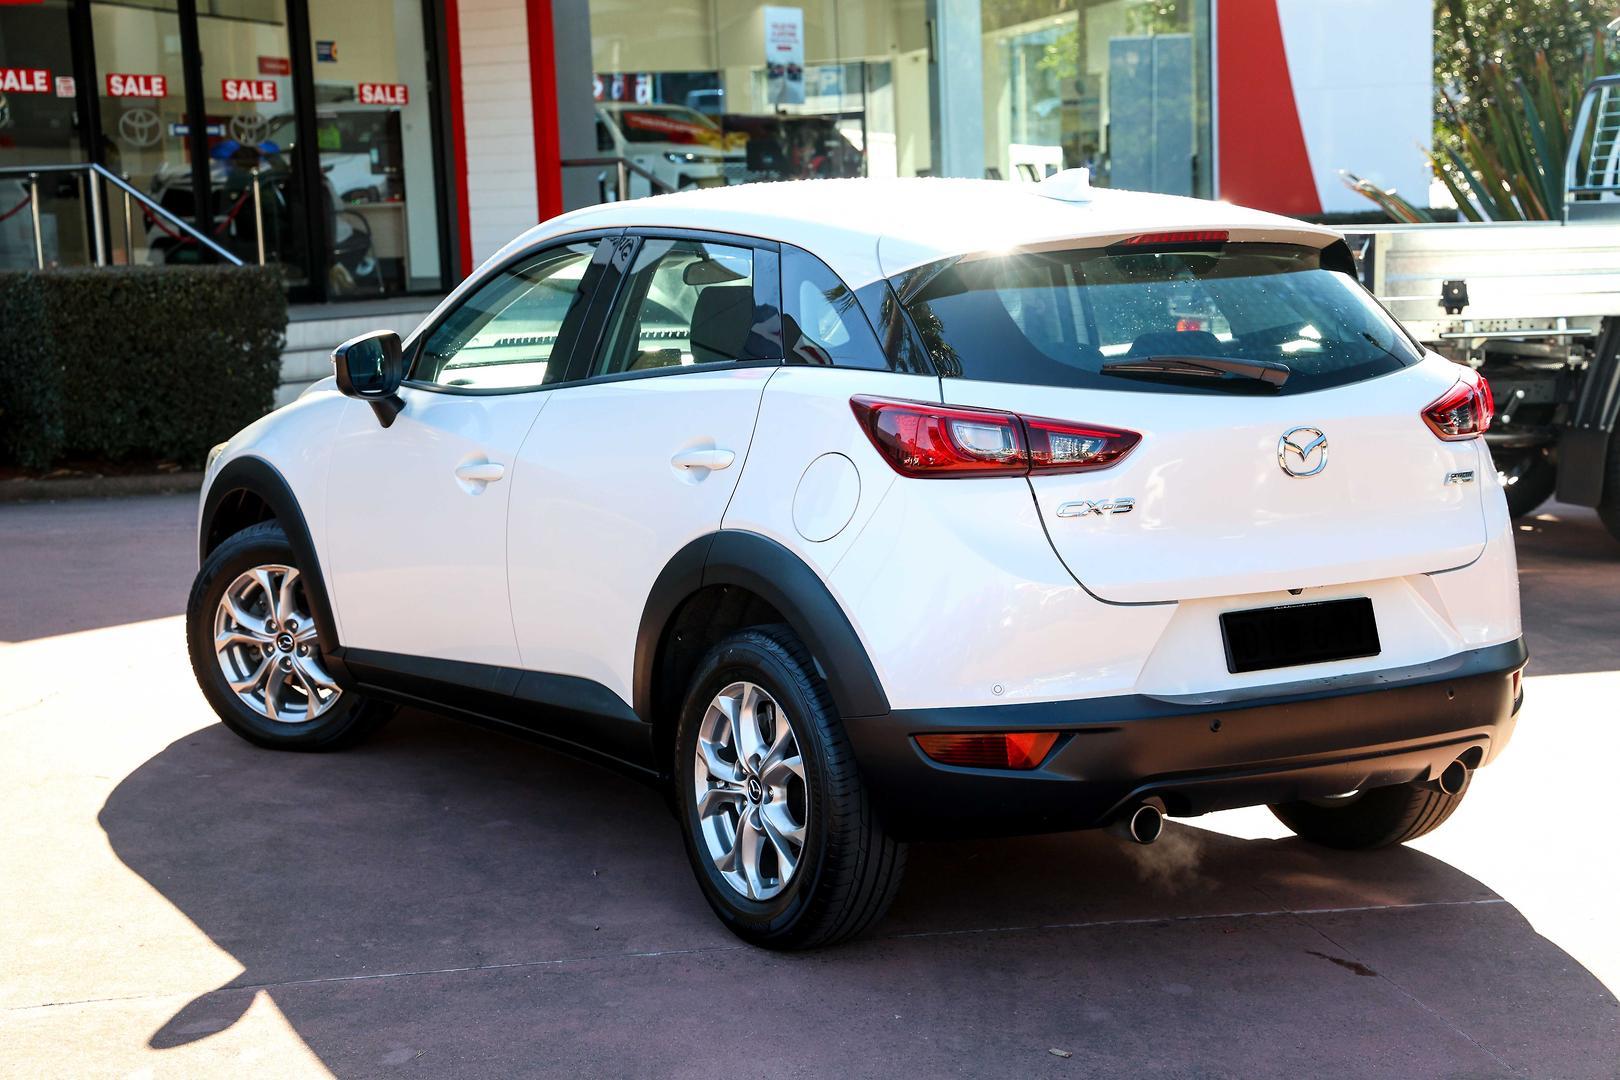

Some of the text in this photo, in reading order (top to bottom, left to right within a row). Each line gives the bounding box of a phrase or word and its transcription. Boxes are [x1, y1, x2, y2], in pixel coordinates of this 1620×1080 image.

[110, 76, 165, 97] SALE
[225, 80, 275, 101] SALE
[362, 85, 407, 104] SALE
[1056, 496, 1136, 518] CX-3
